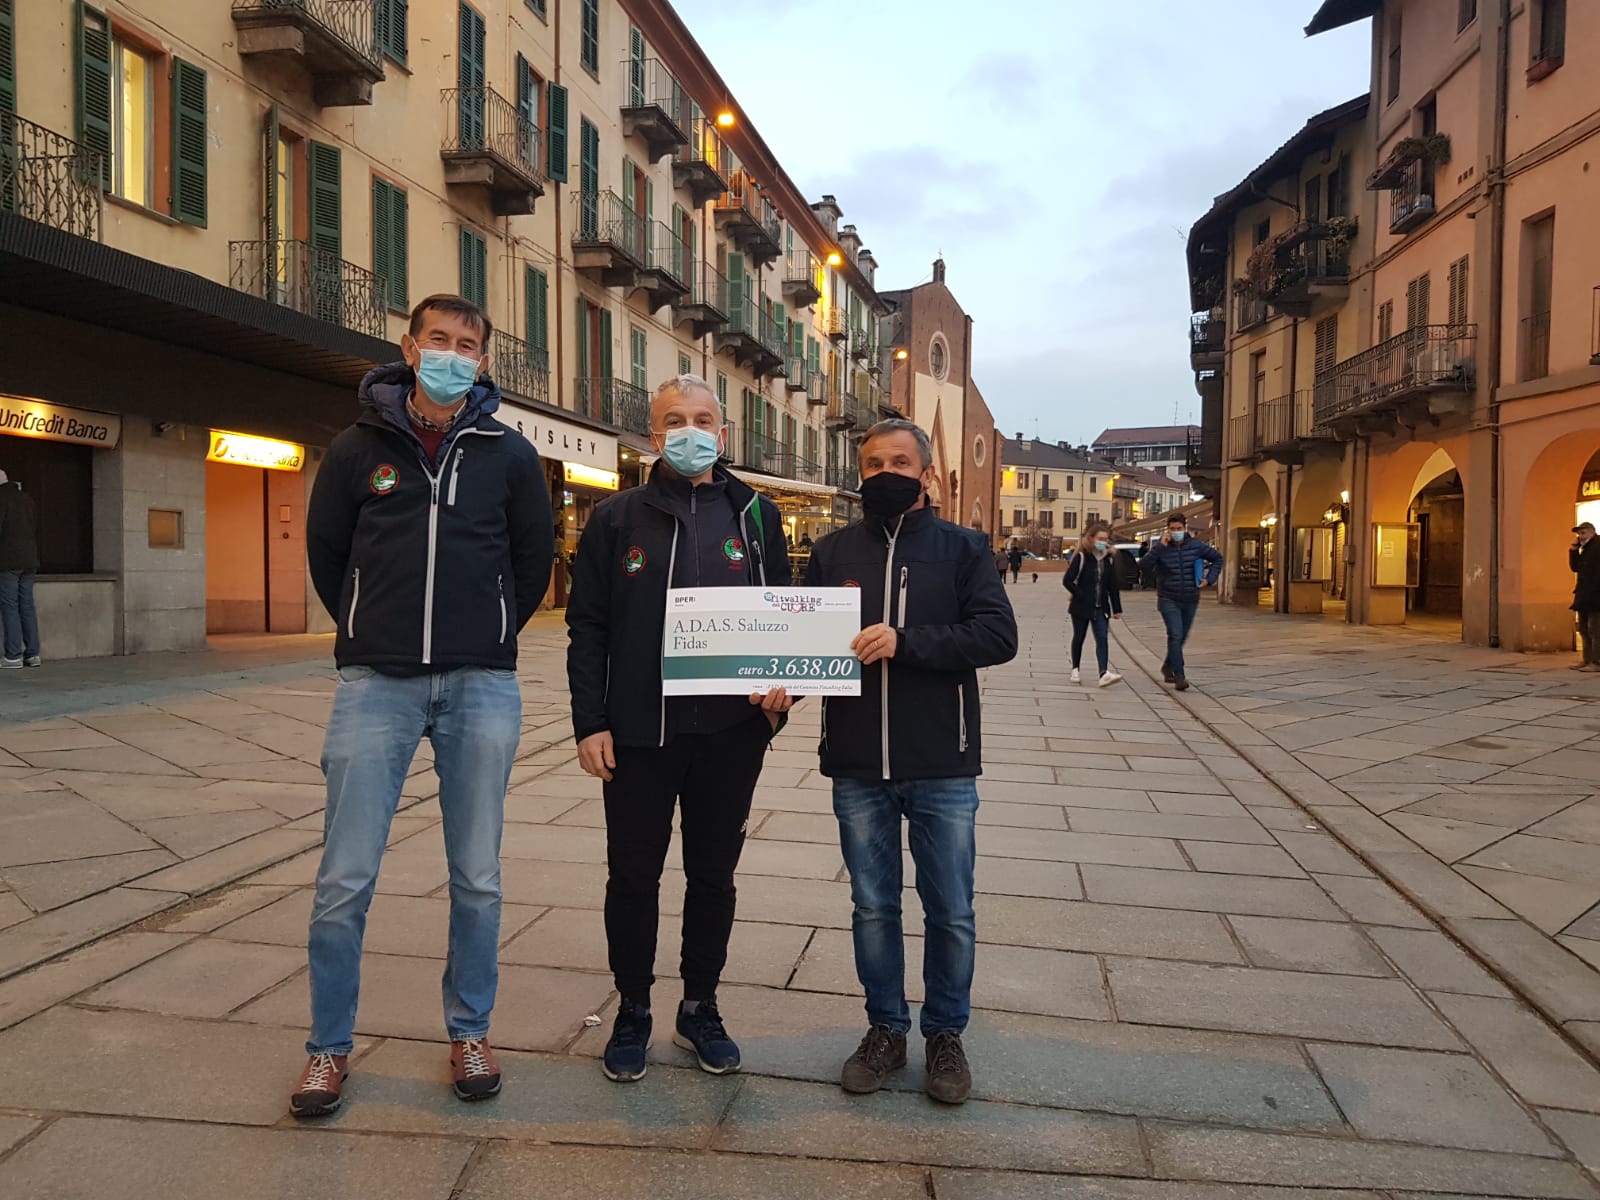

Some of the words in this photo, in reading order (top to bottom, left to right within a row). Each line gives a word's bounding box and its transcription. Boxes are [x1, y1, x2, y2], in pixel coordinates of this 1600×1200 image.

[0, 408, 64, 434] UniCredit
[66, 418, 108, 440] Banca
[517, 421, 596, 455] SISLEY
[673, 618, 734, 633] A.D.A.S.
[738, 617, 789, 632] Saluzzo
[672, 636, 708, 650] Fidas
[738, 666, 763, 676] euro
[765, 658, 853, 679] 3.638,00
